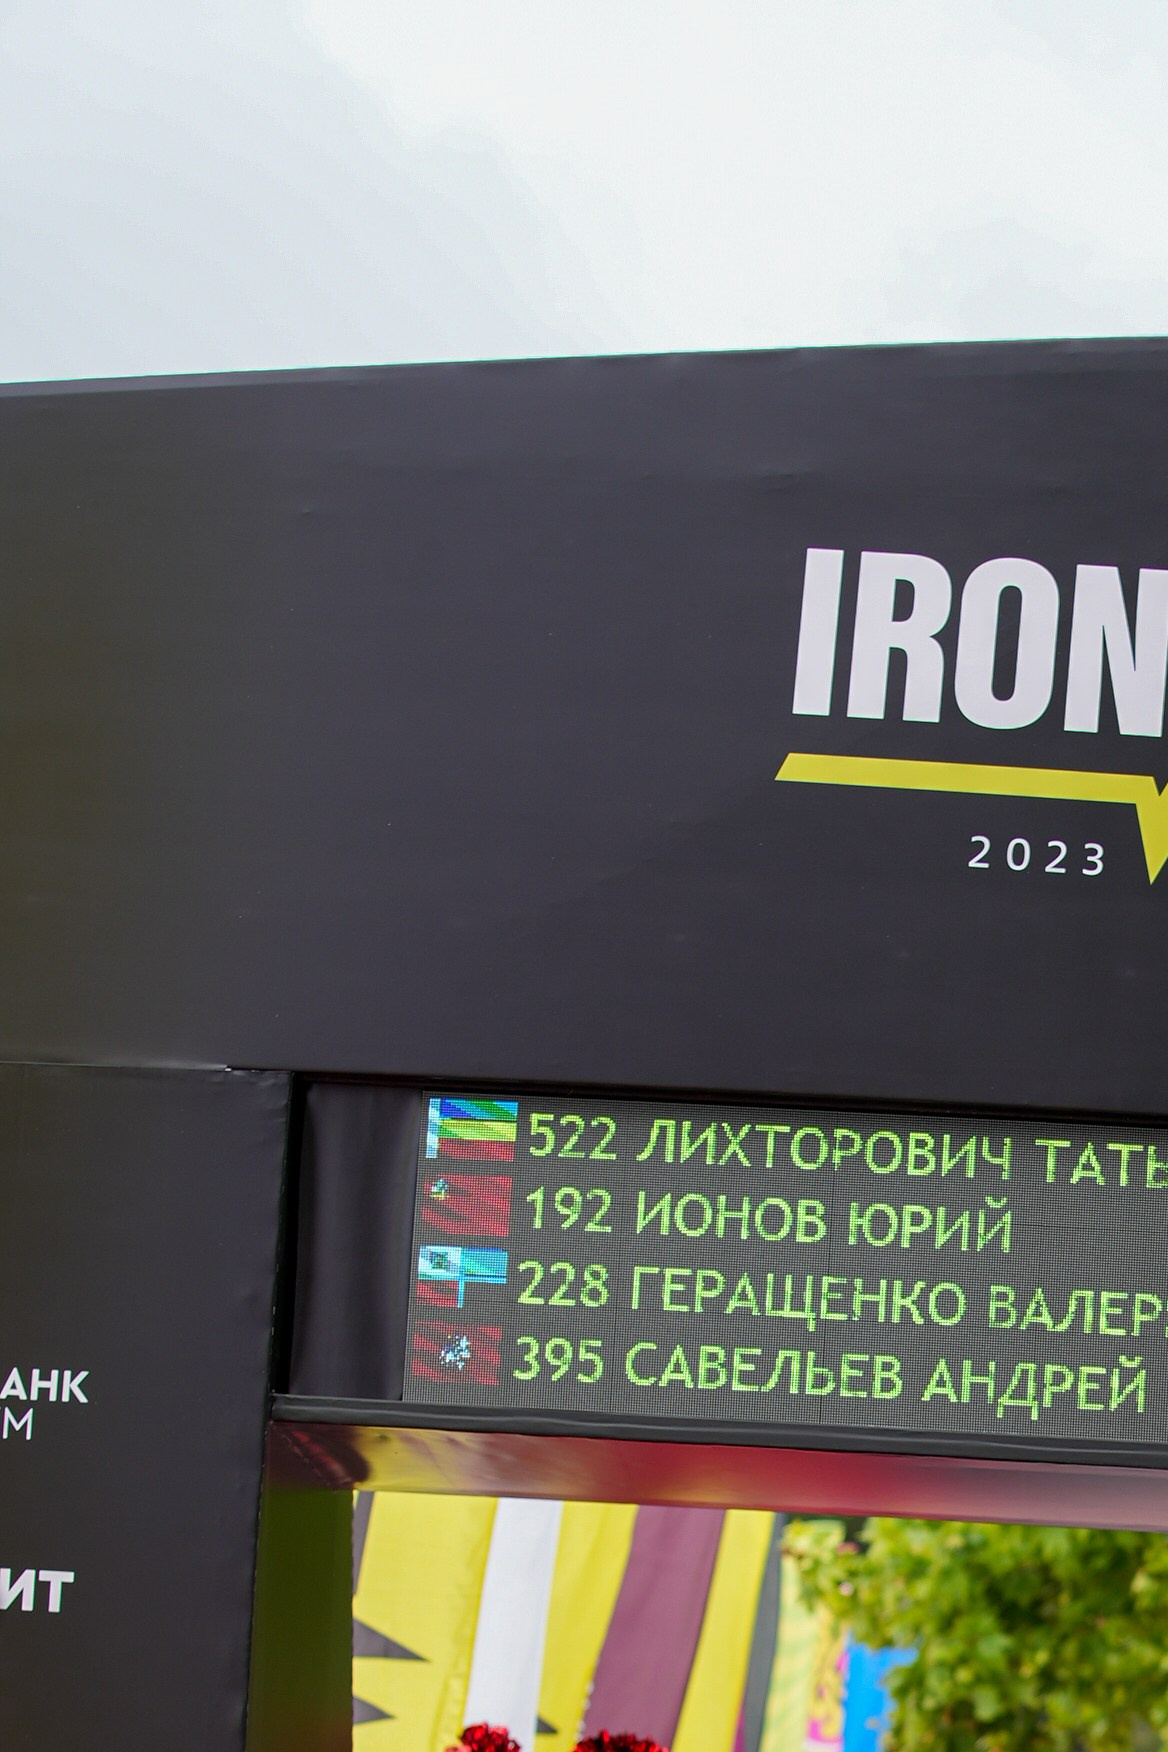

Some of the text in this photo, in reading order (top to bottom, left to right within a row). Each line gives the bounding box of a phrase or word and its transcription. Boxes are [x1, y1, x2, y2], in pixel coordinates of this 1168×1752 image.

[968, 834, 1105, 877] 2023
[529, 1111, 618, 1161] 522
[636, 1117, 1012, 1181] ЛИХТОРОВИЧ
[526, 1185, 612, 1233] 192
[636, 1190, 827, 1244] ИОНОВ
[847, 1196, 1012, 1253] ЮРИЙ
[517, 1260, 609, 1308] 228
[629, 1264, 967, 1333] ГЕРАЩЕНКО
[512, 1335, 605, 1383] 395
[624, 1340, 904, 1400] САВЕЛЬЕВ
[921, 1354, 1148, 1421] АНДРЕЙ
